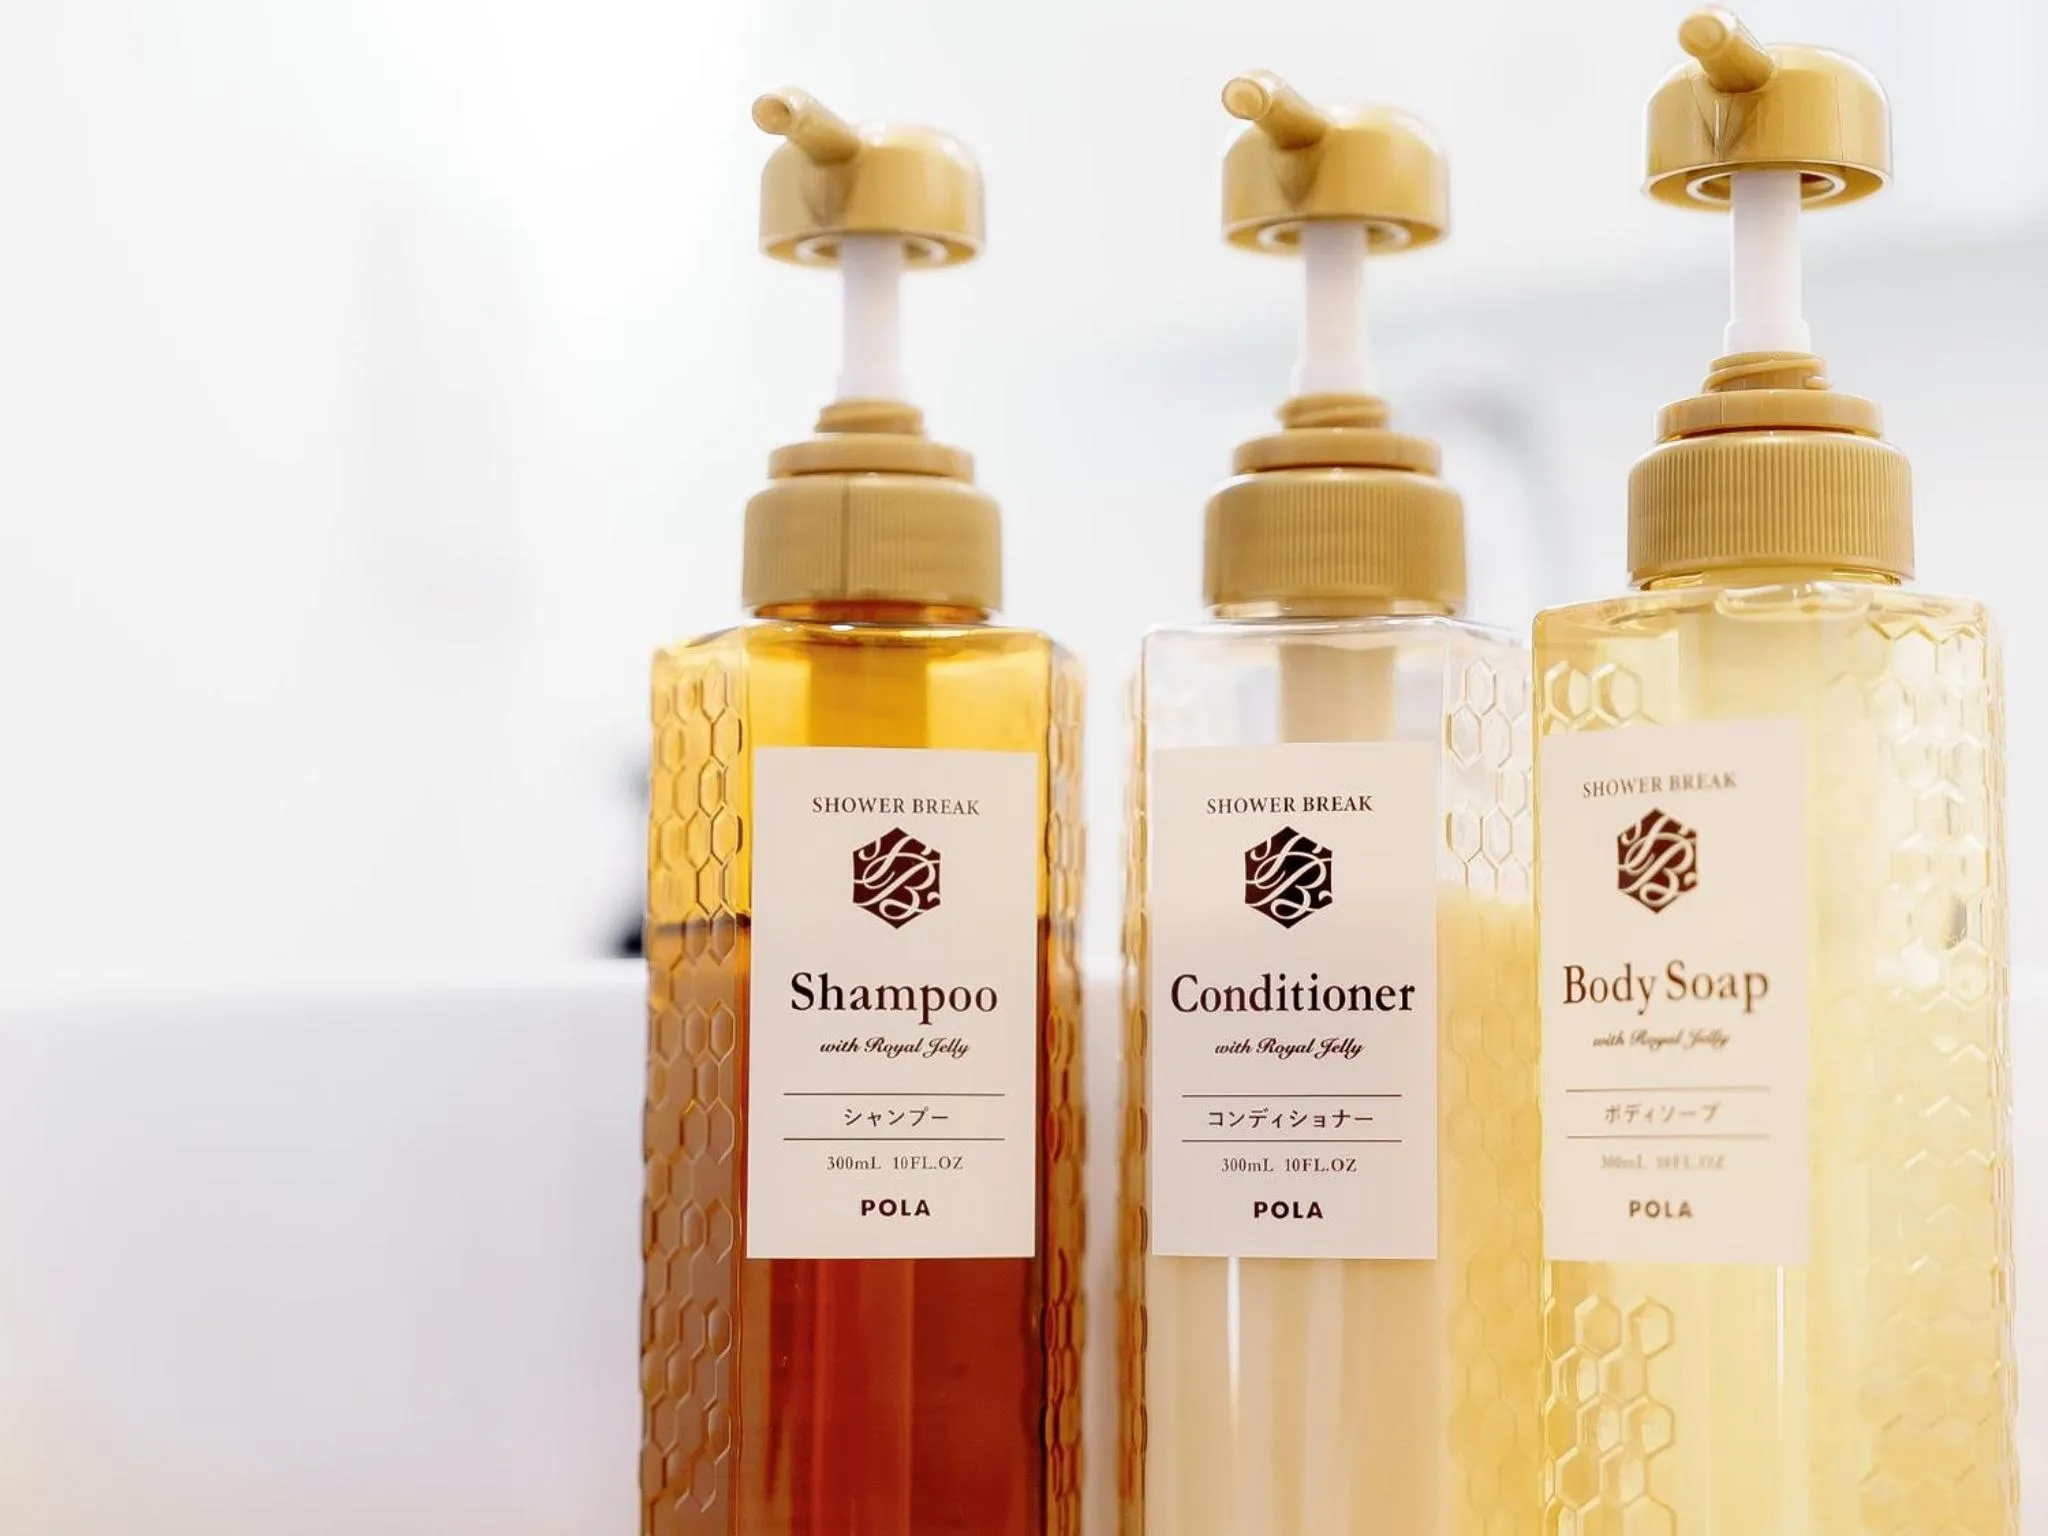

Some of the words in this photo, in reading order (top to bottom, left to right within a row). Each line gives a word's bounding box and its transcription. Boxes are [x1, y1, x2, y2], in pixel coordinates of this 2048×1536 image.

[1583, 776, 1663, 799] SHOWER
[1669, 772, 1737, 792] BREAK
[812, 796, 905, 814] SHOWER
[912, 798, 980, 816] BREAK
[1207, 796, 1296, 815] SHOWER
[1302, 795, 1373, 812] BREAK
[791, 971, 998, 1026] Shampoo
[1170, 972, 1416, 1013] Conditioner
[1563, 963, 1655, 1016] Body
[1665, 960, 1769, 1014] Soap
[818, 1037, 861, 1054] with
[863, 1036, 923, 1059] Royal
[922, 1037, 970, 1060] Jelly
[1214, 1038, 1253, 1054] with
[1255, 1037, 1315, 1060] Royal
[1314, 1037, 1365, 1060] Jelly
[1592, 1030, 1626, 1047] with
[844, 1106, 949, 1128] シャンプー
[1208, 1107, 1374, 1129] コンディショナー
[1604, 1102, 1720, 1125] ボディソープ
[827, 1155, 882, 1170] 300mL
[893, 1155, 963, 1170] 10FL.OZ
[1221, 1157, 1274, 1172] 300mL
[1286, 1157, 1357, 1173] 10FL.OZ
[861, 1198, 931, 1217] POLA
[1253, 1200, 1324, 1220] POLA
[1628, 1199, 1693, 1219] POLA
